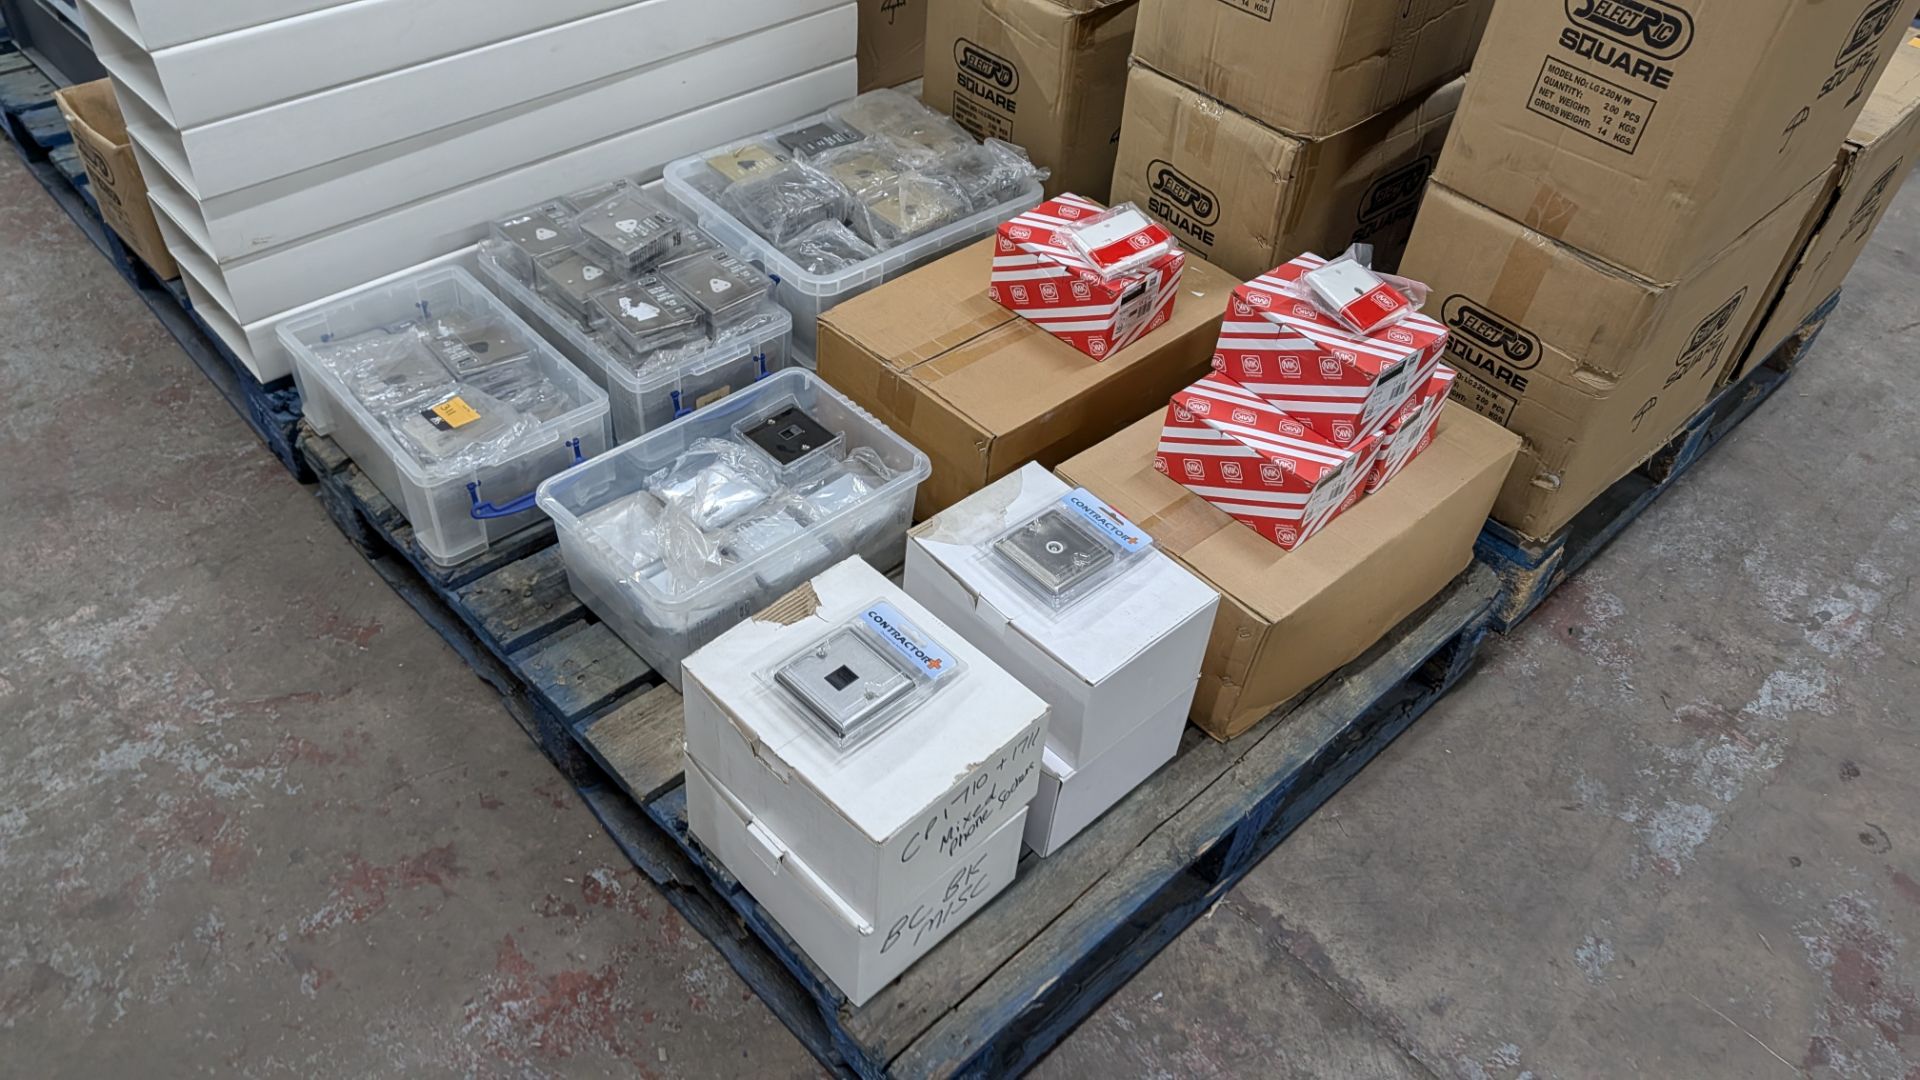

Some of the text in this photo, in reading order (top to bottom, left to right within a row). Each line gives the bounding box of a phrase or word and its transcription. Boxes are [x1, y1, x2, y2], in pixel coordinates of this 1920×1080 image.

[1254, 2, 1268, 14] KGS
[1547, 64, 1573, 81] MODEL
[1574, 76, 1589, 89] NO:
[1559, 27, 1674, 90] SQUARE
[957, 72, 1017, 114] SQUARE
[1538, 86, 1637, 136] NET WEIGHT: 12 KGS
[1543, 75, 1641, 124] QUANTITY: 200 PCS
[1534, 98, 1632, 146] GROSS WEIGHT: 14 KGS
[1153, 169, 1213, 219] SELECTRIC
[1148, 197, 1215, 247] SQUARE
[1449, 305, 1534, 361] SELECTRIC
[1445, 335, 1529, 393] SQUARE
[1071, 497, 1130, 541] CONTRACTOR
[868, 610, 930, 663] CONTRACTOR
[1012, 728, 1041, 761] 1711
[940, 783, 998, 853] Mixed
[943, 853, 988, 903] BK
[913, 873, 992, 947] MISC
